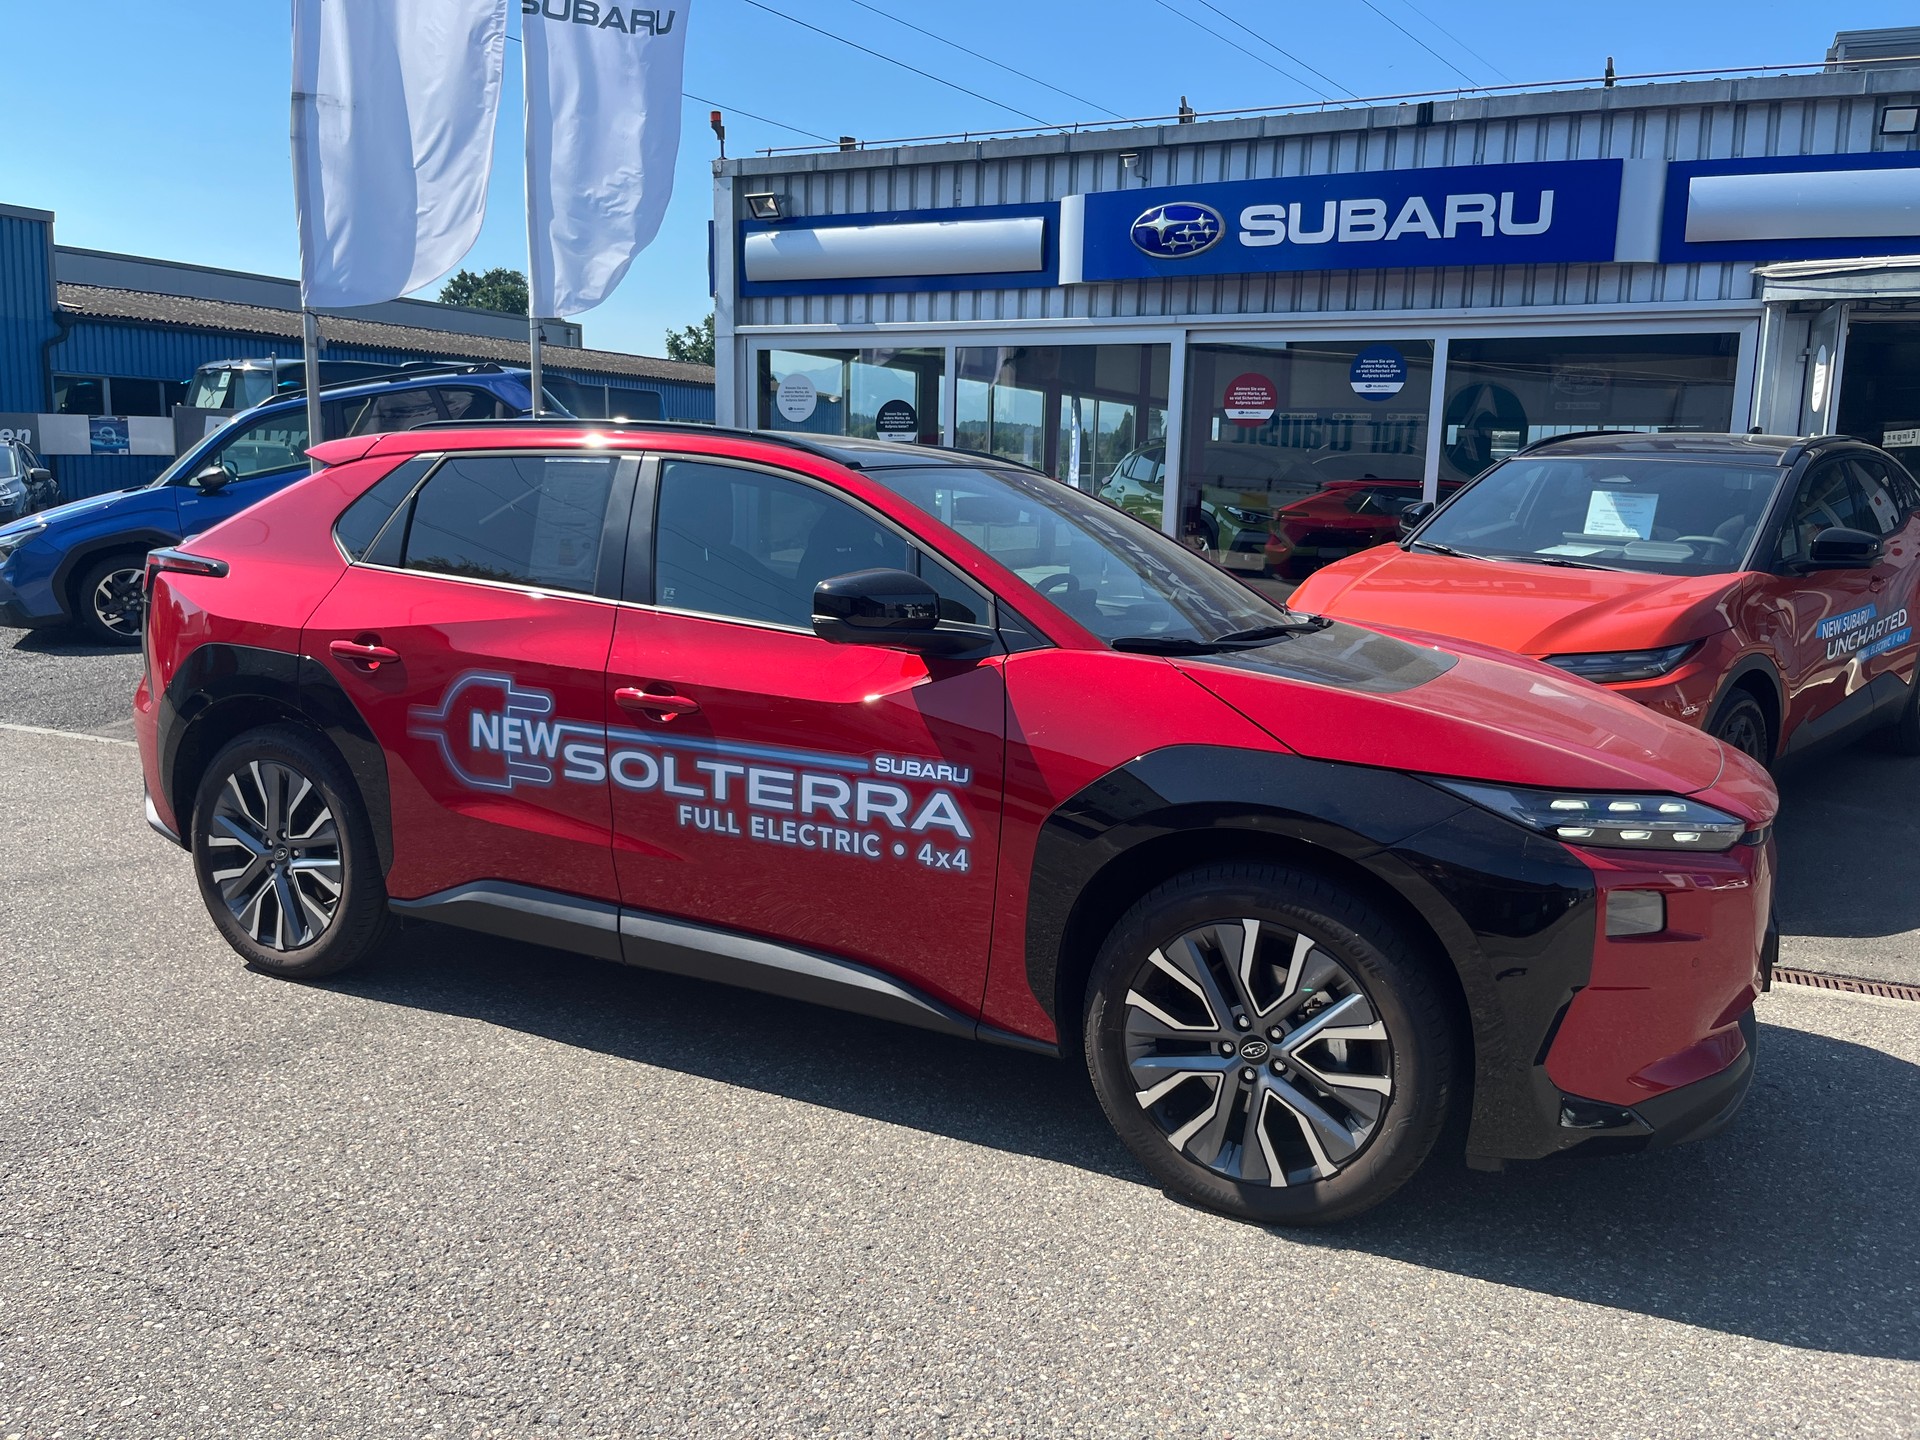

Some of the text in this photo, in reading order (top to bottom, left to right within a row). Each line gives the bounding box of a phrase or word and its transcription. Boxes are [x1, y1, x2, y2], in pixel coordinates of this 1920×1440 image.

[1239, 190, 1554, 247] SUBARU
[1822, 608, 1870, 640] NEW SUBARU
[1826, 608, 1908, 660] UNCHARTED
[471, 712, 972, 838] NEW SOLTERRA
[874, 756, 970, 784] SUBARU
[680, 804, 970, 872] FULL ELECTRIC 4x4
